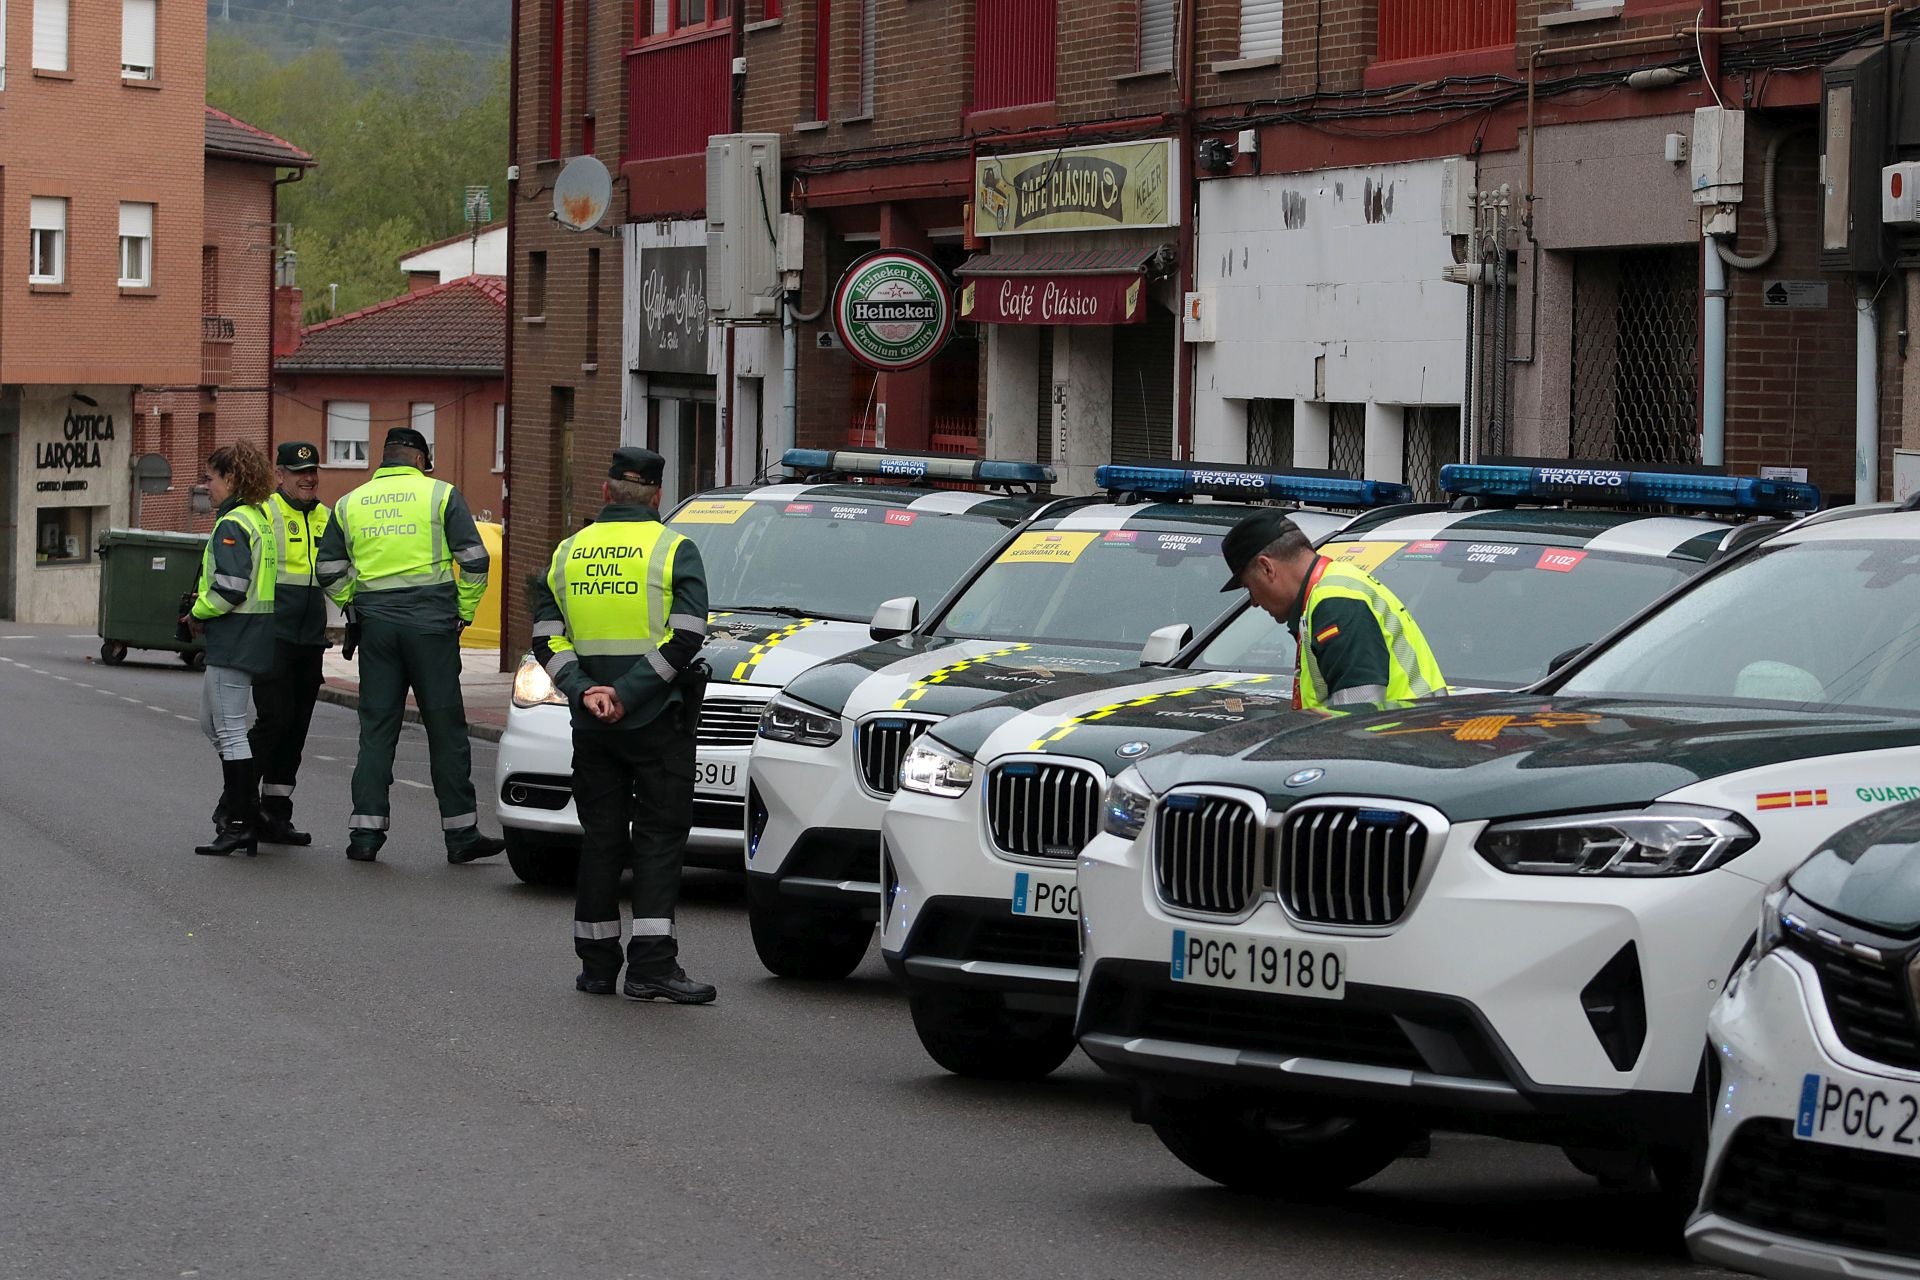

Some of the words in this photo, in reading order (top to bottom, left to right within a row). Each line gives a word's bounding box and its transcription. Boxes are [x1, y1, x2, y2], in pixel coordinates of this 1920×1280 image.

[1021, 167, 1048, 217] CAFÉ
[1052, 163, 1099, 208] CLÁSICO
[1136, 164, 1162, 209] KELER
[856, 267, 908, 295] Heineken
[909, 269, 932, 295] Beer
[1000, 279, 1035, 321] Café
[1042, 281, 1098, 320] Clásico
[855, 304, 934, 319] Heineken
[856, 328, 898, 357] Premium
[900, 328, 933, 356] Quality
[881, 465, 924, 475] TRAFICO
[1193, 470, 1238, 478] GUARDIA
[1240, 472, 1265, 480] CIVIL
[1541, 467, 1591, 476] GUARDIA
[1192, 475, 1265, 487] TRAFICO
[1539, 473, 1622, 486] TRAFICO
[361, 491, 417, 506] GUARDIA
[374, 507, 403, 520] CIVIL
[830, 506, 869, 515] GUARDIA
[834, 512, 856, 520] CIVIL
[889, 513, 911, 522] 1105
[1158, 534, 1203, 545] GUARDIA
[572, 546, 644, 560] GUARDIA
[1162, 542, 1187, 551] CIVIL
[1467, 544, 1519, 556] GUARDIA
[1467, 553, 1497, 563] CIVIL
[1544, 554, 1577, 566] 1102
[586, 563, 623, 577] CIVIL
[571, 578, 638, 595] TRÁFICO
[1188, 937, 1237, 980] PGC
[1820, 1083, 1888, 1139] PGC
